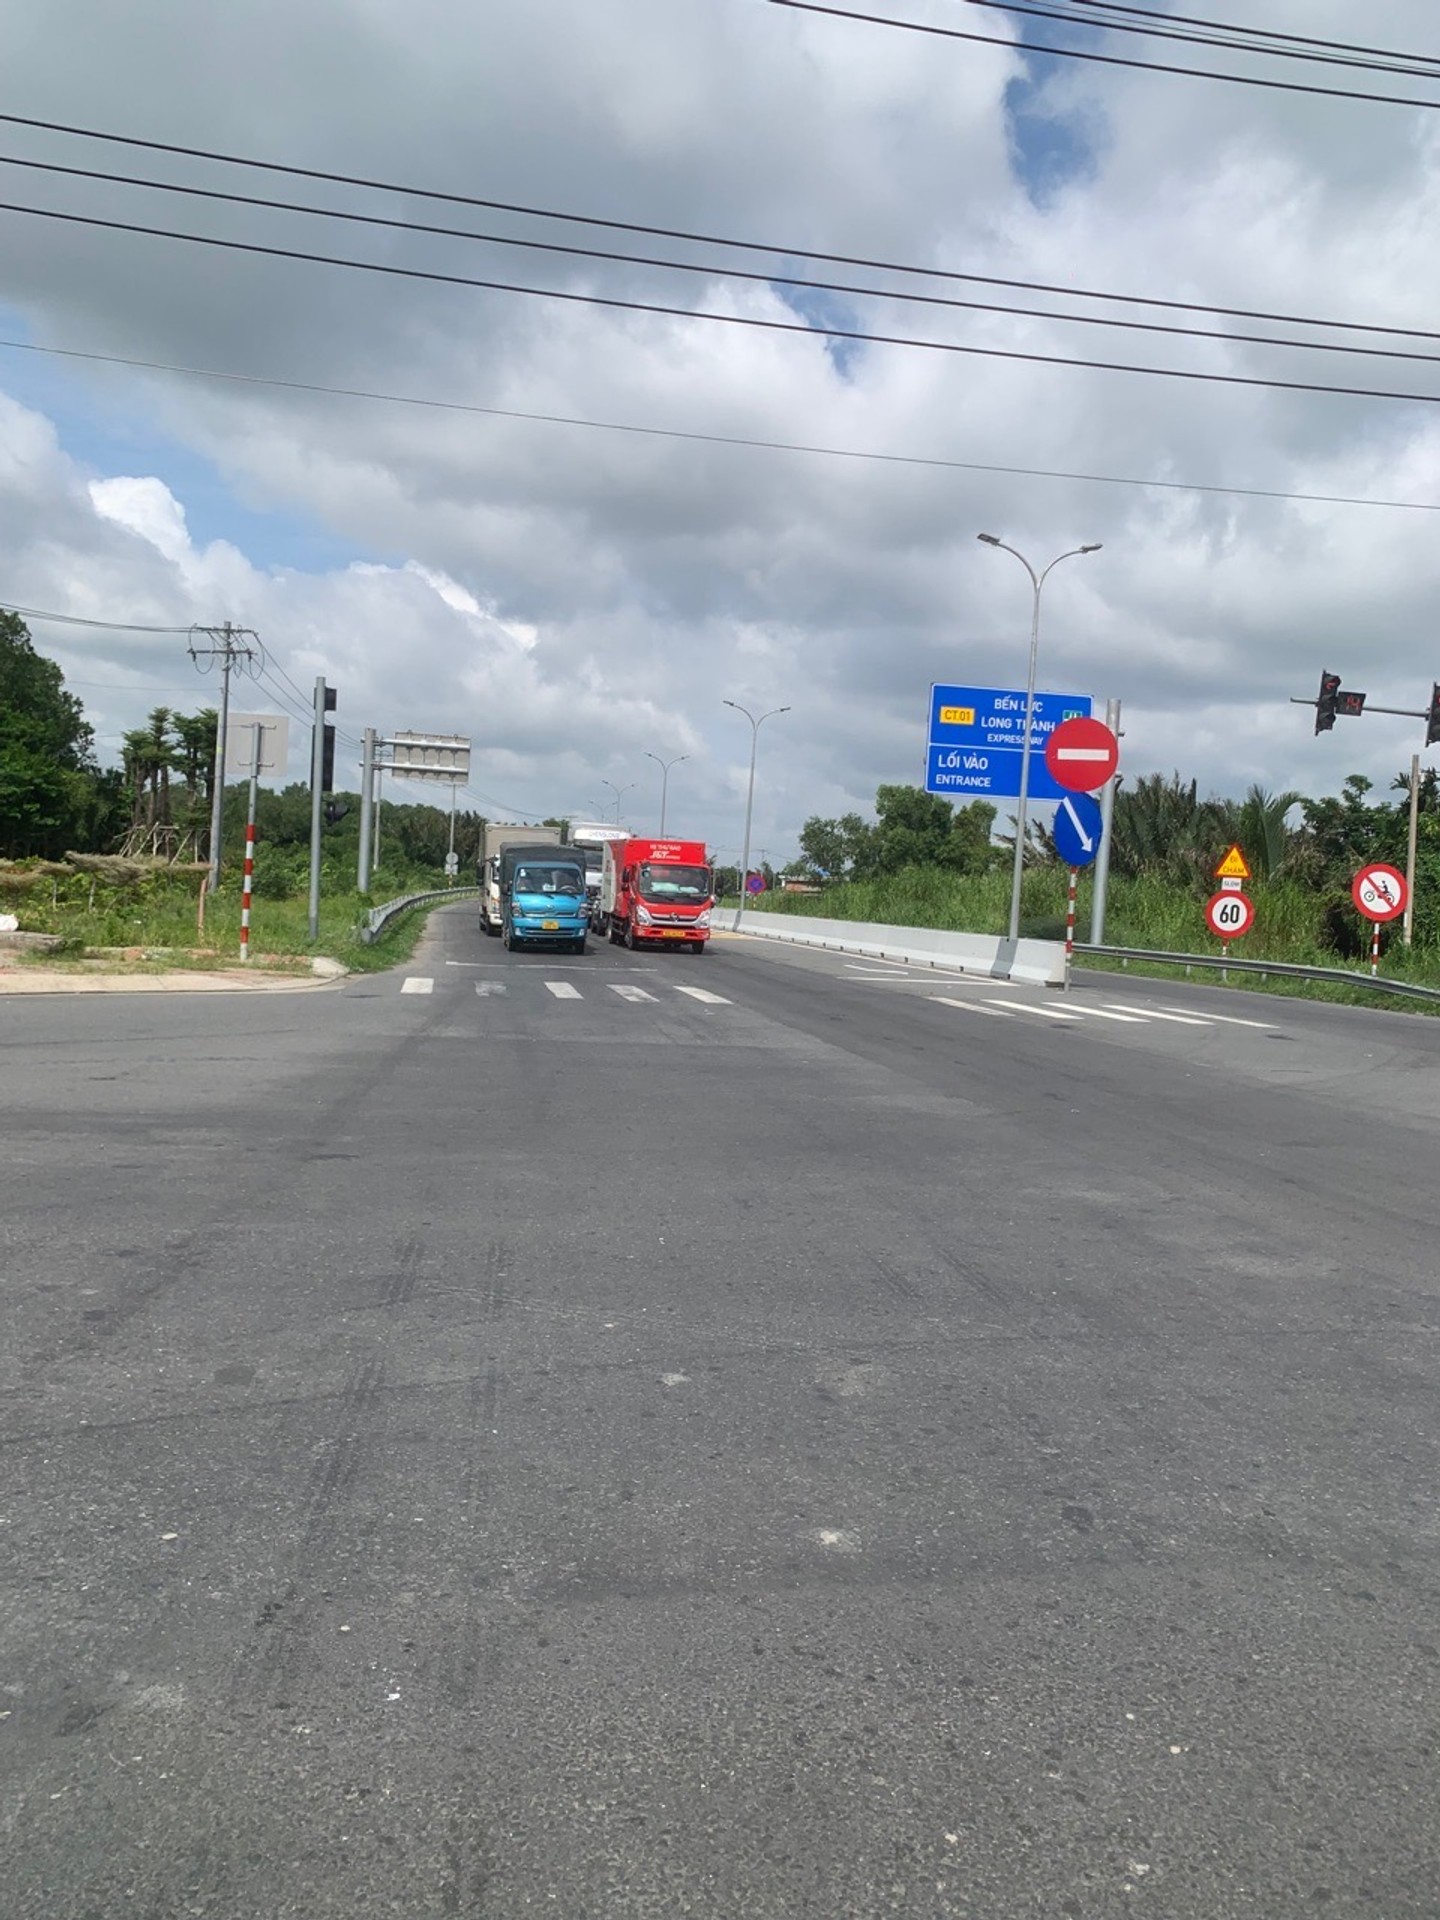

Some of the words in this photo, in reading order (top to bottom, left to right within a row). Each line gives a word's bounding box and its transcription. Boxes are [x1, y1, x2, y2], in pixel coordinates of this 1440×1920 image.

[994, 695, 1018, 710] BẾN
[945, 709, 970, 721] CT.01
[981, 716, 1012, 729] LONG
[938, 750, 960, 768] LỐI
[963, 752, 988, 770] VÀO
[935, 774, 991, 787] ENTRANCE
[1219, 904, 1240, 923] 60
